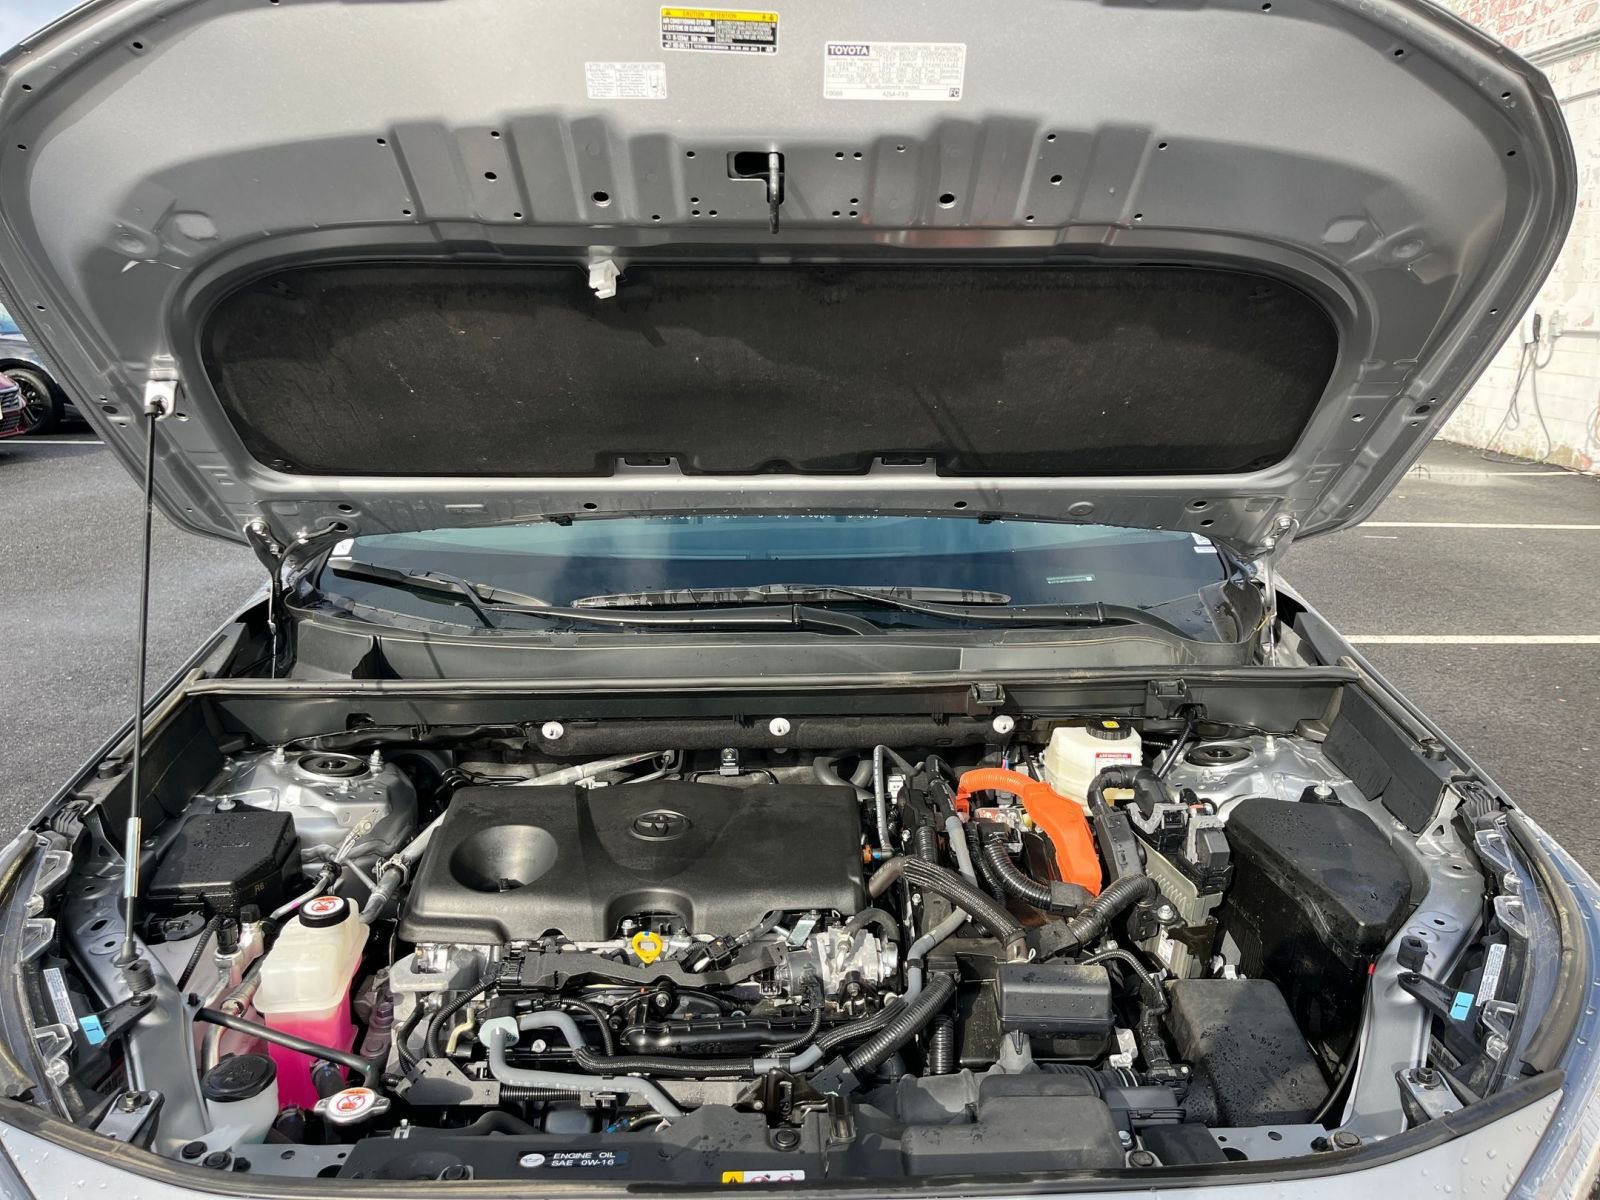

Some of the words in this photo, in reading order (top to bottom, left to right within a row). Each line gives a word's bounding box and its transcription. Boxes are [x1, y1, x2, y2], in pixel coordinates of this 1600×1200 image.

[829, 45, 869, 56] TOYOTA
[553, 1152, 592, 1160] ENGINE
[598, 1151, 616, 1159] OIL
[551, 1159, 573, 1167] SAE
